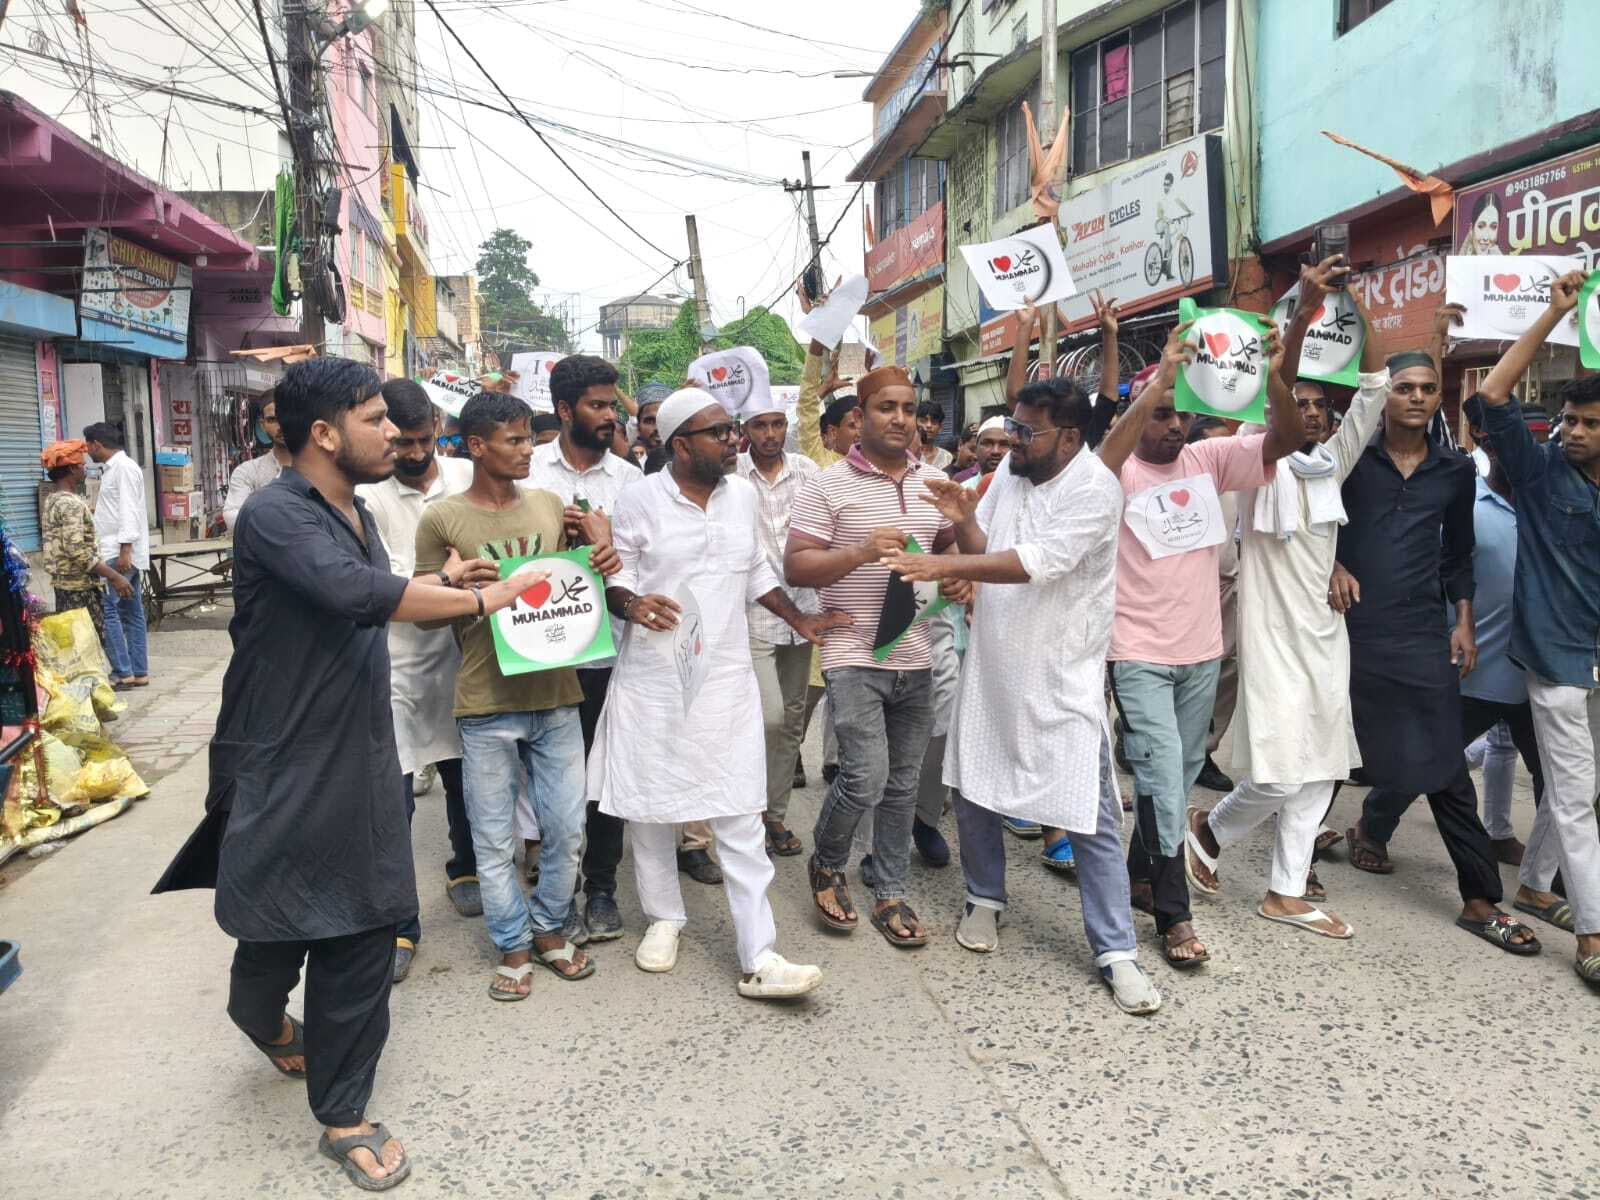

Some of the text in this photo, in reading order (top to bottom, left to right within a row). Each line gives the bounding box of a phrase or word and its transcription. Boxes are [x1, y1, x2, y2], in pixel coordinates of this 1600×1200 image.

[1072, 200, 1141, 243] AVON CYCLES
[111, 240, 138, 264] SHIV
[988, 260, 996, 274] I
[995, 265, 1041, 281] MUHAMMAD
[1484, 275, 1490, 292] I
[1484, 293, 1552, 304] MUHAMMAD
[534, 359, 540, 375] I
[1196, 352, 1257, 376] MUHAMMAD
[706, 371, 712, 383] I
[709, 377, 746, 391] MUHAMMAD
[431, 378, 475, 398] MUHAMMA
[1156, 495, 1168, 513] I
[512, 603, 593, 626] MUHAMMAD
